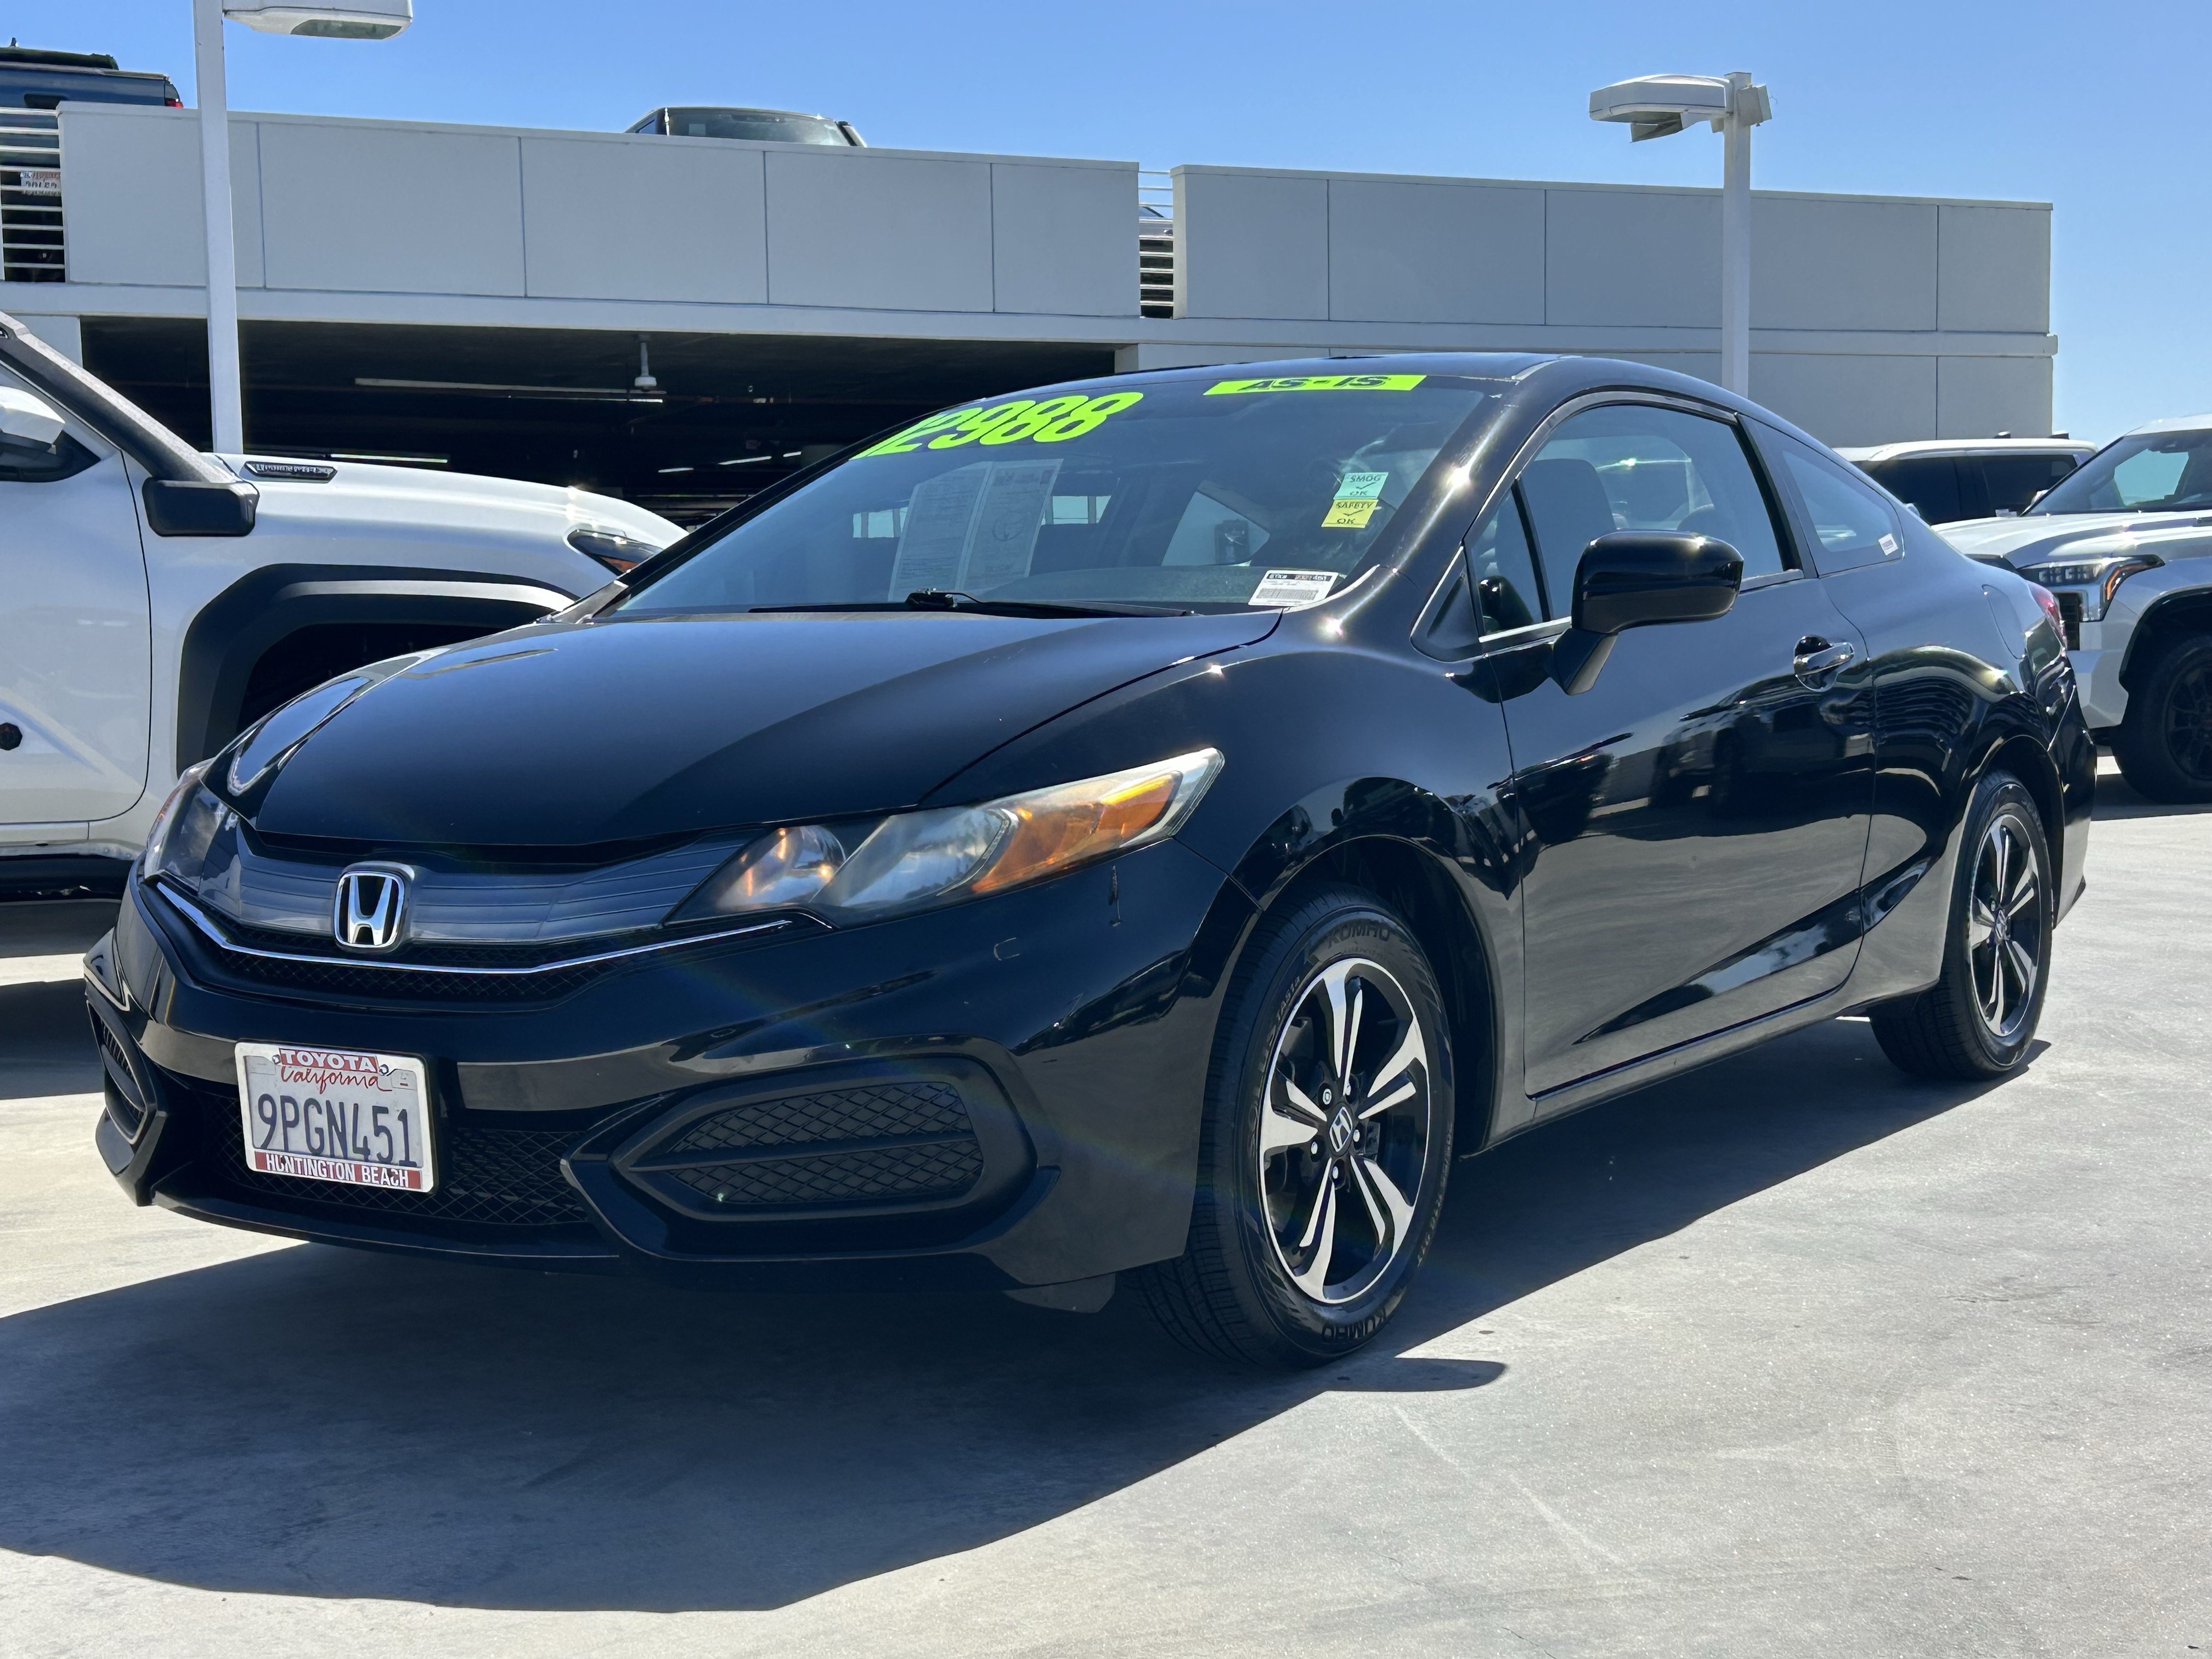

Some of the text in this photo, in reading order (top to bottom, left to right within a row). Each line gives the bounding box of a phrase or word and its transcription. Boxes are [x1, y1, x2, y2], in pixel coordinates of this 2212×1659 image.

[1237, 375, 1391, 392] AS-IS
[1349, 475, 1381, 483] SMOG
[1328, 918, 1390, 949] KUMHO
[280, 1050, 377, 1072] TOYOTA
[280, 1065, 392, 1094] California
[257, 1093, 417, 1168] 9PGN451
[266, 1153, 409, 1188] HUNTINGTON BEACH
[1322, 1307, 1387, 1343] KUMHO
